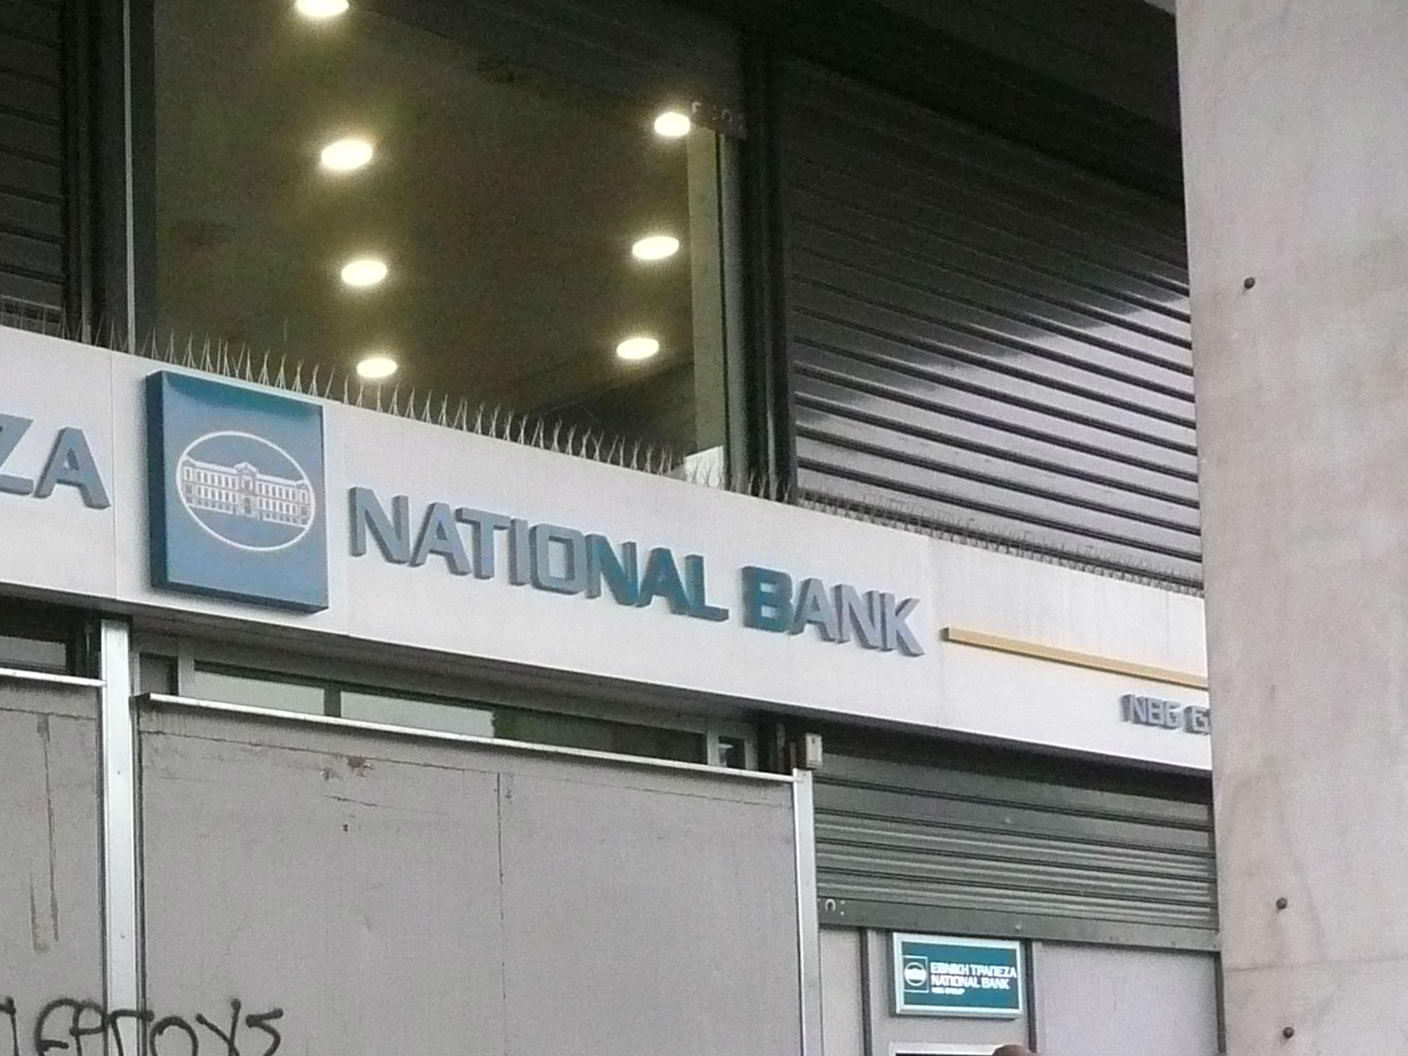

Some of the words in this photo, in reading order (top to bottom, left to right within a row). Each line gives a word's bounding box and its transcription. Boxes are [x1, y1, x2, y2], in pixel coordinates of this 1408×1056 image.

[348, 486, 729, 621] NATIONAL
[741, 565, 924, 657] BANK
[1120, 694, 1183, 730] NBG
[1183, 705, 1211, 735] G
[931, 974, 981, 988] NATIONAL
[981, 977, 1011, 990] BANK
